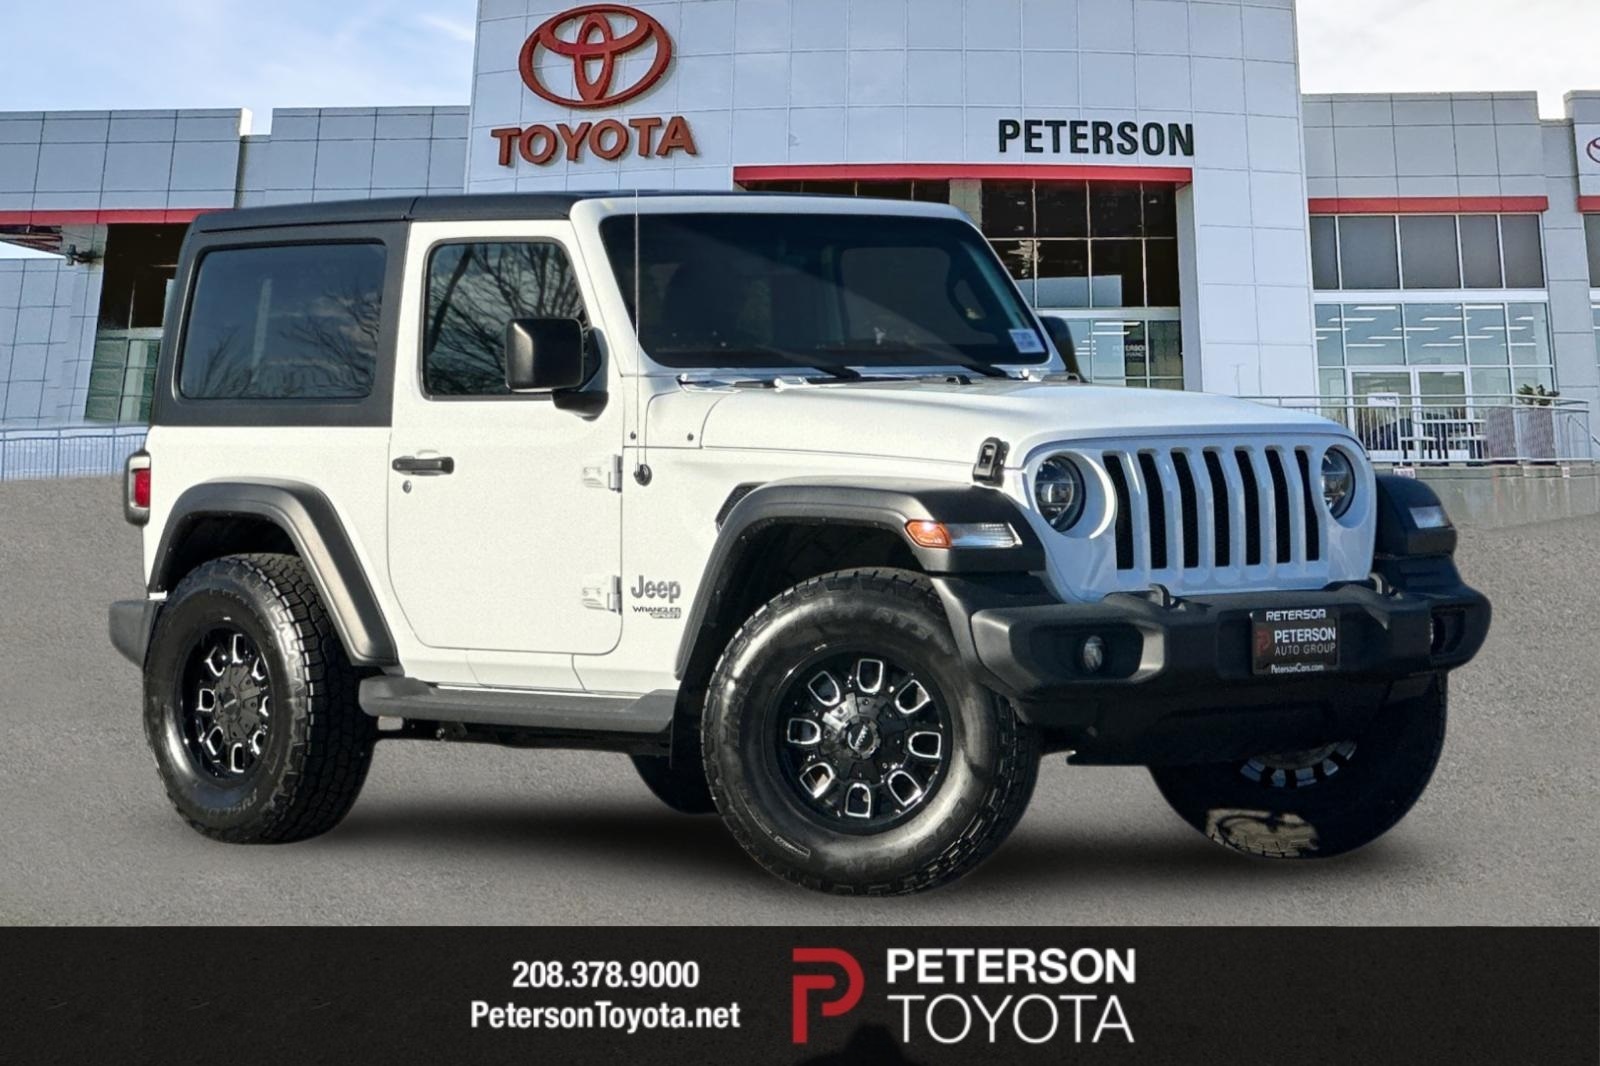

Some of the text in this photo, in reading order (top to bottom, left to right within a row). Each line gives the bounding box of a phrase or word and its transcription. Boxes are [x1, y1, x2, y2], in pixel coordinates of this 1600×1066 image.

[491, 116, 697, 166] TOYOTA
[999, 119, 1195, 156] PETERSON
[630, 574, 681, 604] Jeep
[1274, 627, 1336, 644] PETERSON
[1274, 642, 1336, 657] AUTO GROUP
